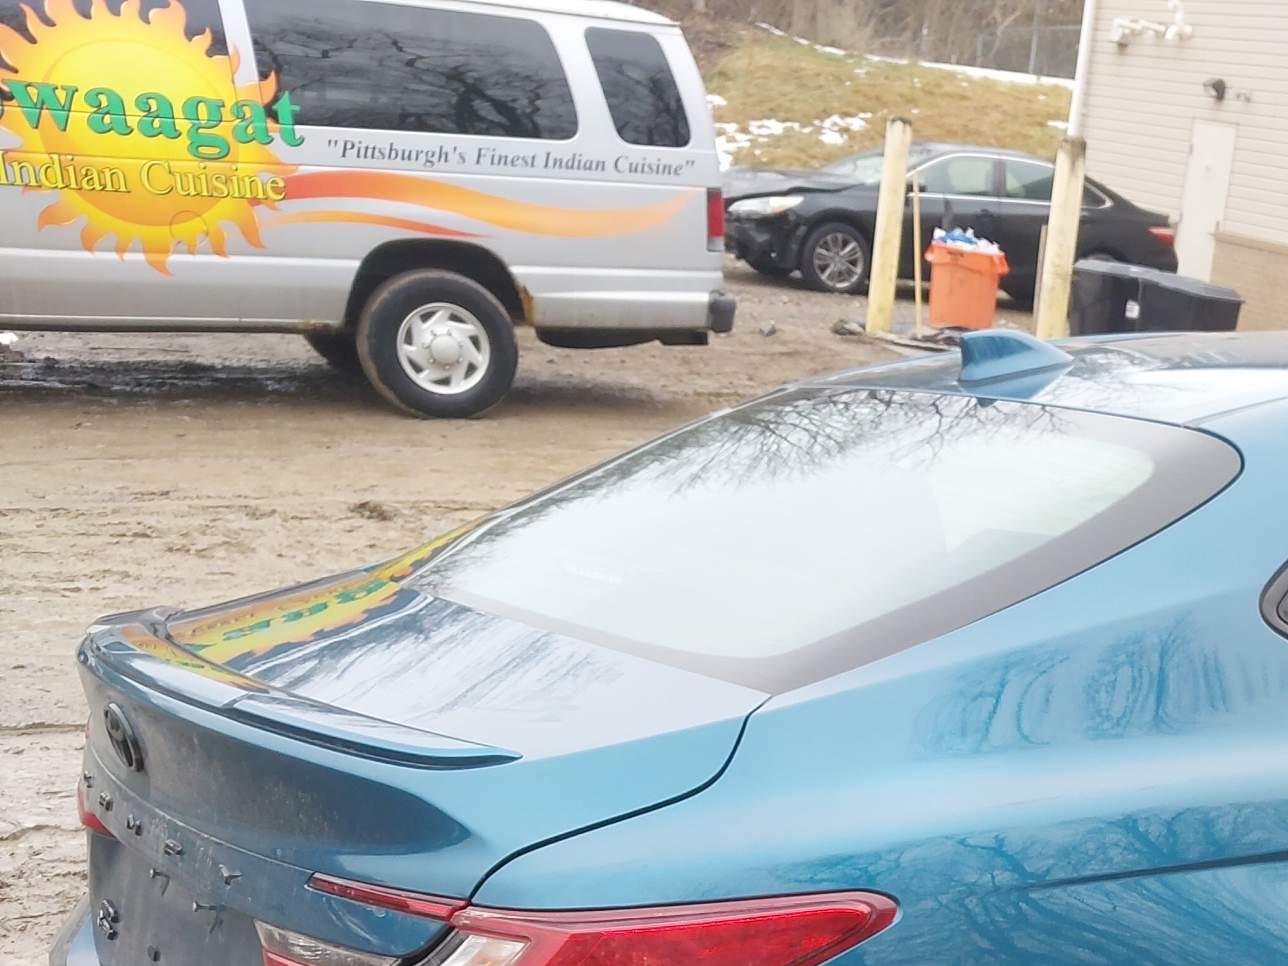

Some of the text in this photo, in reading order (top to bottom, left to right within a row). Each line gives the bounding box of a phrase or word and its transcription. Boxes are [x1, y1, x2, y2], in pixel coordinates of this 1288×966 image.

[0, 78, 305, 160] waagat
[0, 150, 287, 201] Indian Cuisine
[326, 138, 696, 178] "Pittsburgh's Finest Indian Cuisine"
